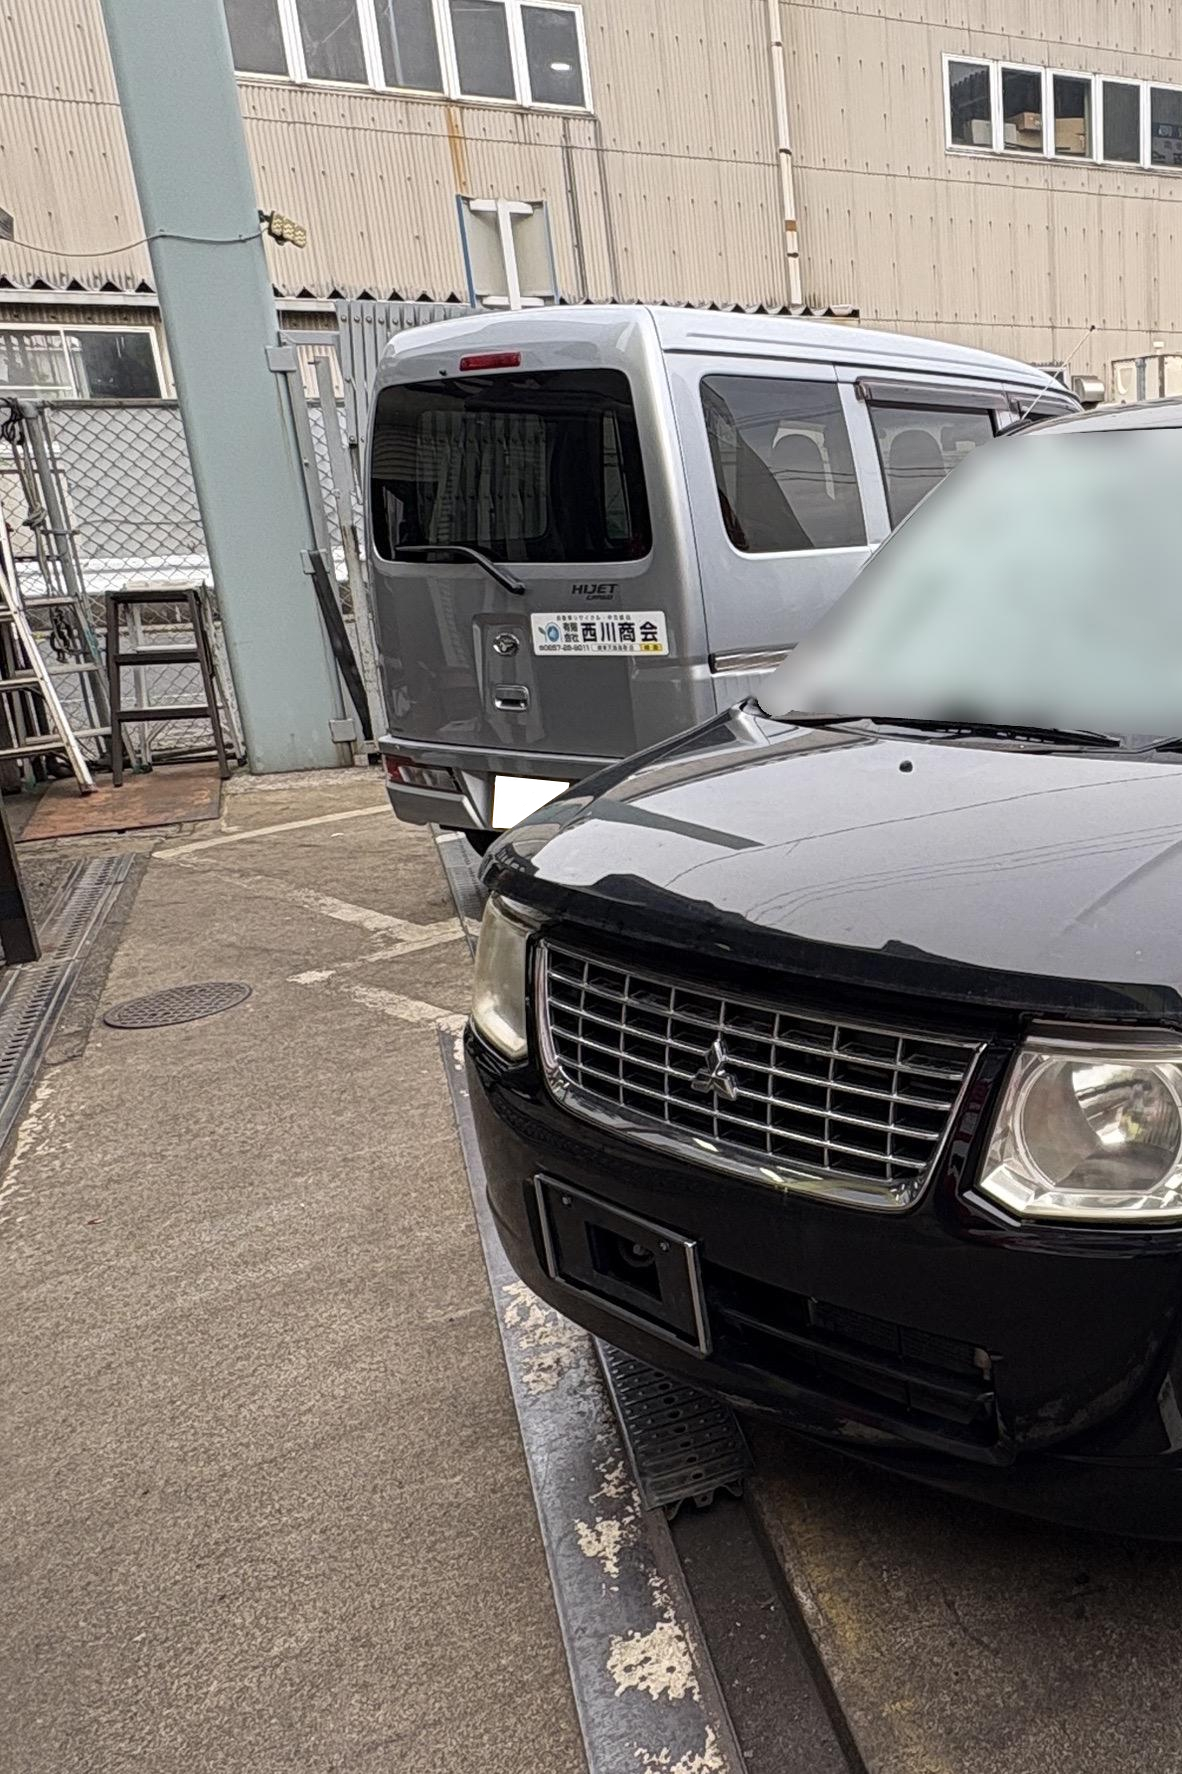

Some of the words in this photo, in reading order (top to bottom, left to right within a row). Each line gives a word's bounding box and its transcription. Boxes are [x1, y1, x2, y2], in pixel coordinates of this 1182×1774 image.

[571, 583, 618, 594] HIJET
[580, 621, 658, 642] 西川商会
